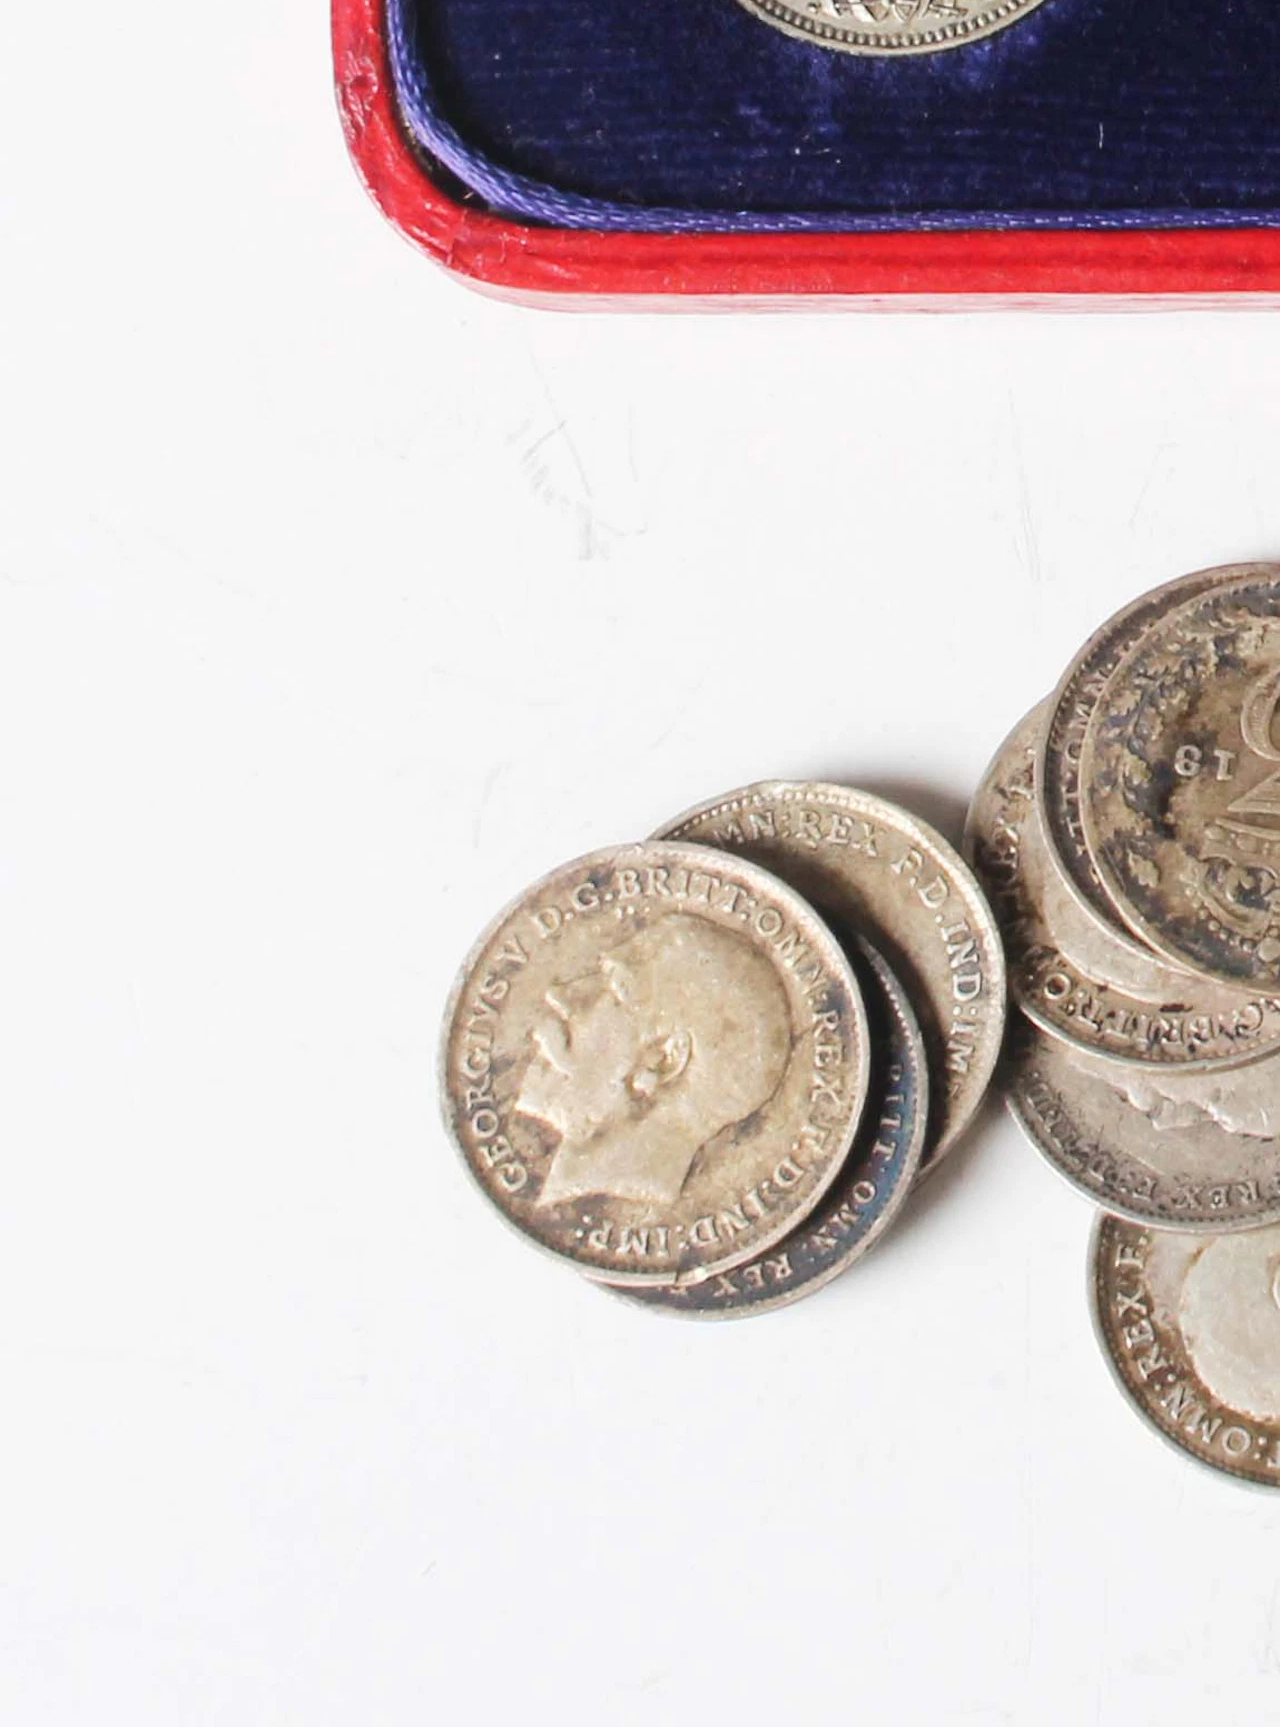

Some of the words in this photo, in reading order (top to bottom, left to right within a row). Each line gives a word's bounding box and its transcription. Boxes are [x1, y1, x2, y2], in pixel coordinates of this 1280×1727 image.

[1173, 744, 1237, 782] 18
[491, 935, 532, 977] V
[461, 970, 532, 1194] GEORGIVS
